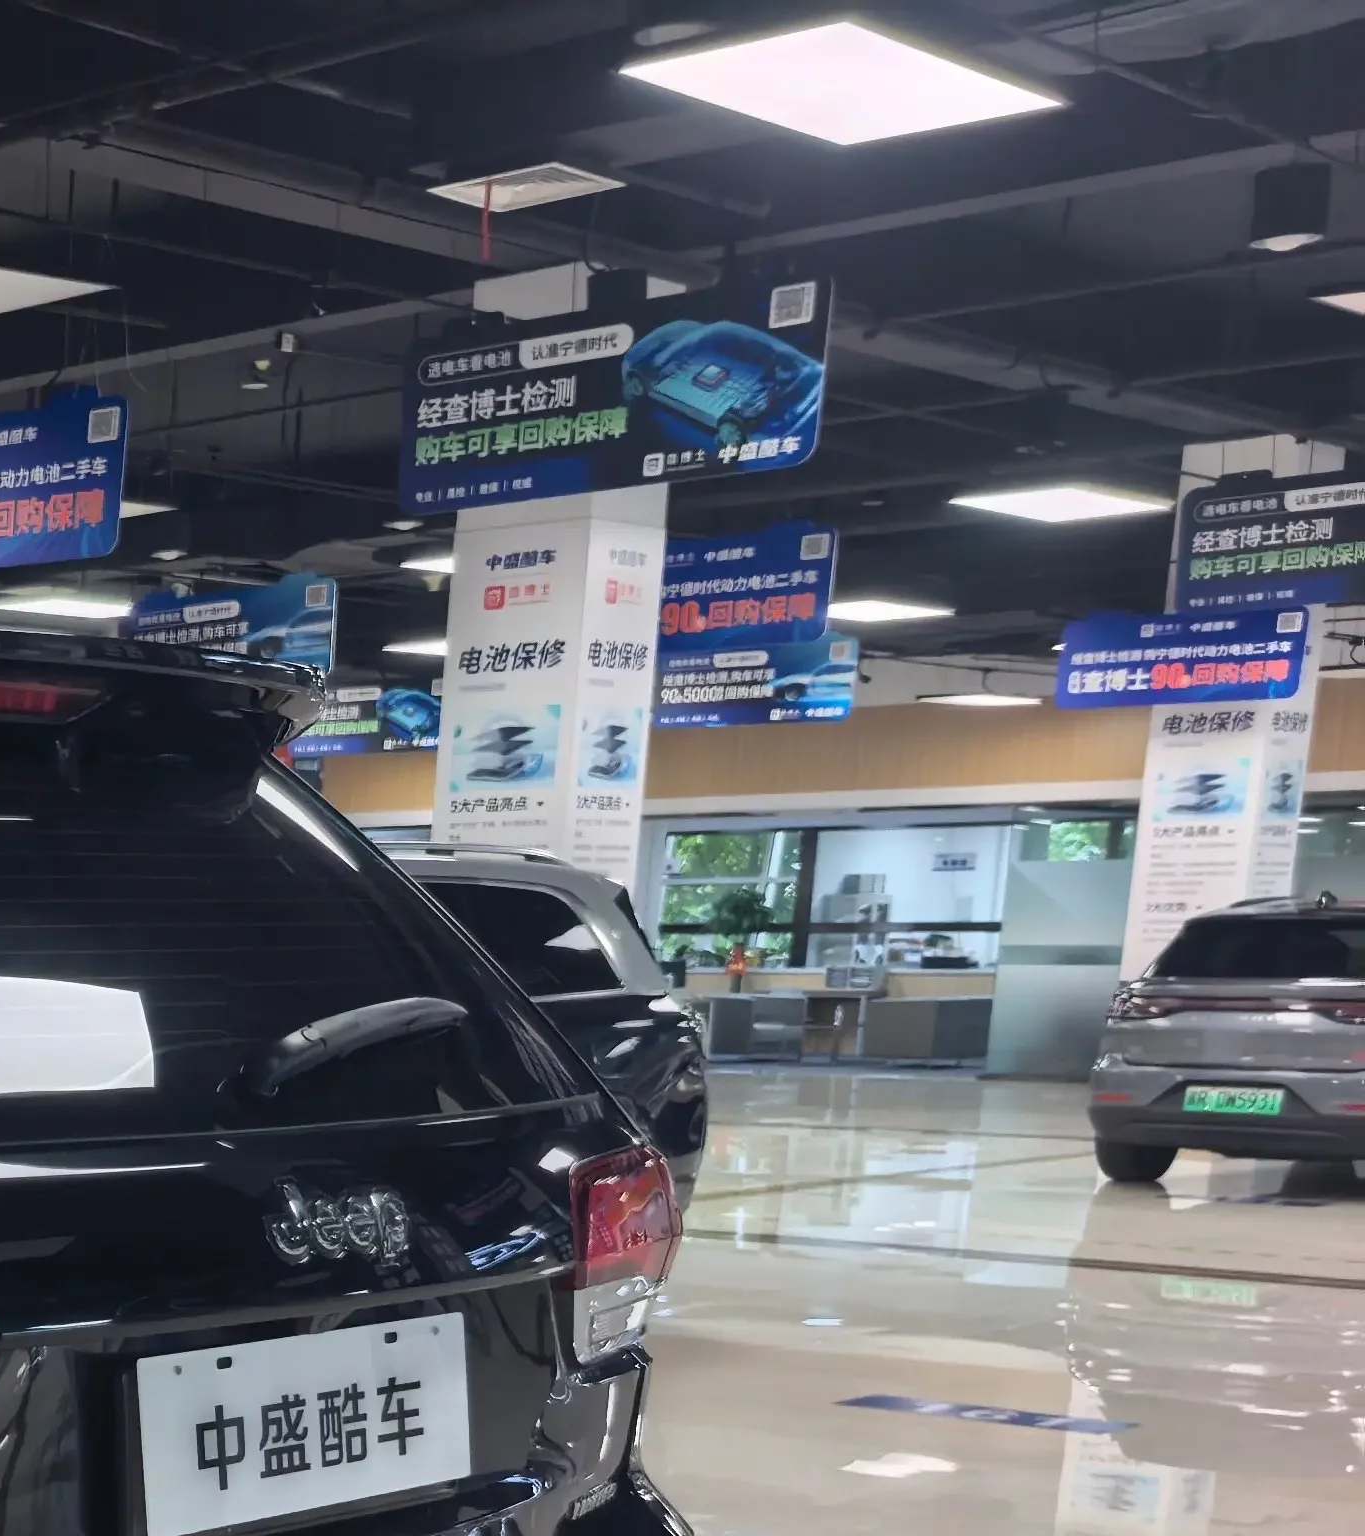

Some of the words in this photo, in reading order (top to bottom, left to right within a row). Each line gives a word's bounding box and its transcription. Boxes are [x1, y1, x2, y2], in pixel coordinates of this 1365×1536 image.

[417, 375, 577, 429] 经查博士检测
[415, 406, 628, 466] 购车可享回购保障
[1192, 517, 1333, 553] 经查博士检测
[458, 638, 566, 675] 电池保修
[1162, 710, 1255, 735] 电池保修
[195, 1376, 425, 1491] 中盛酷车
